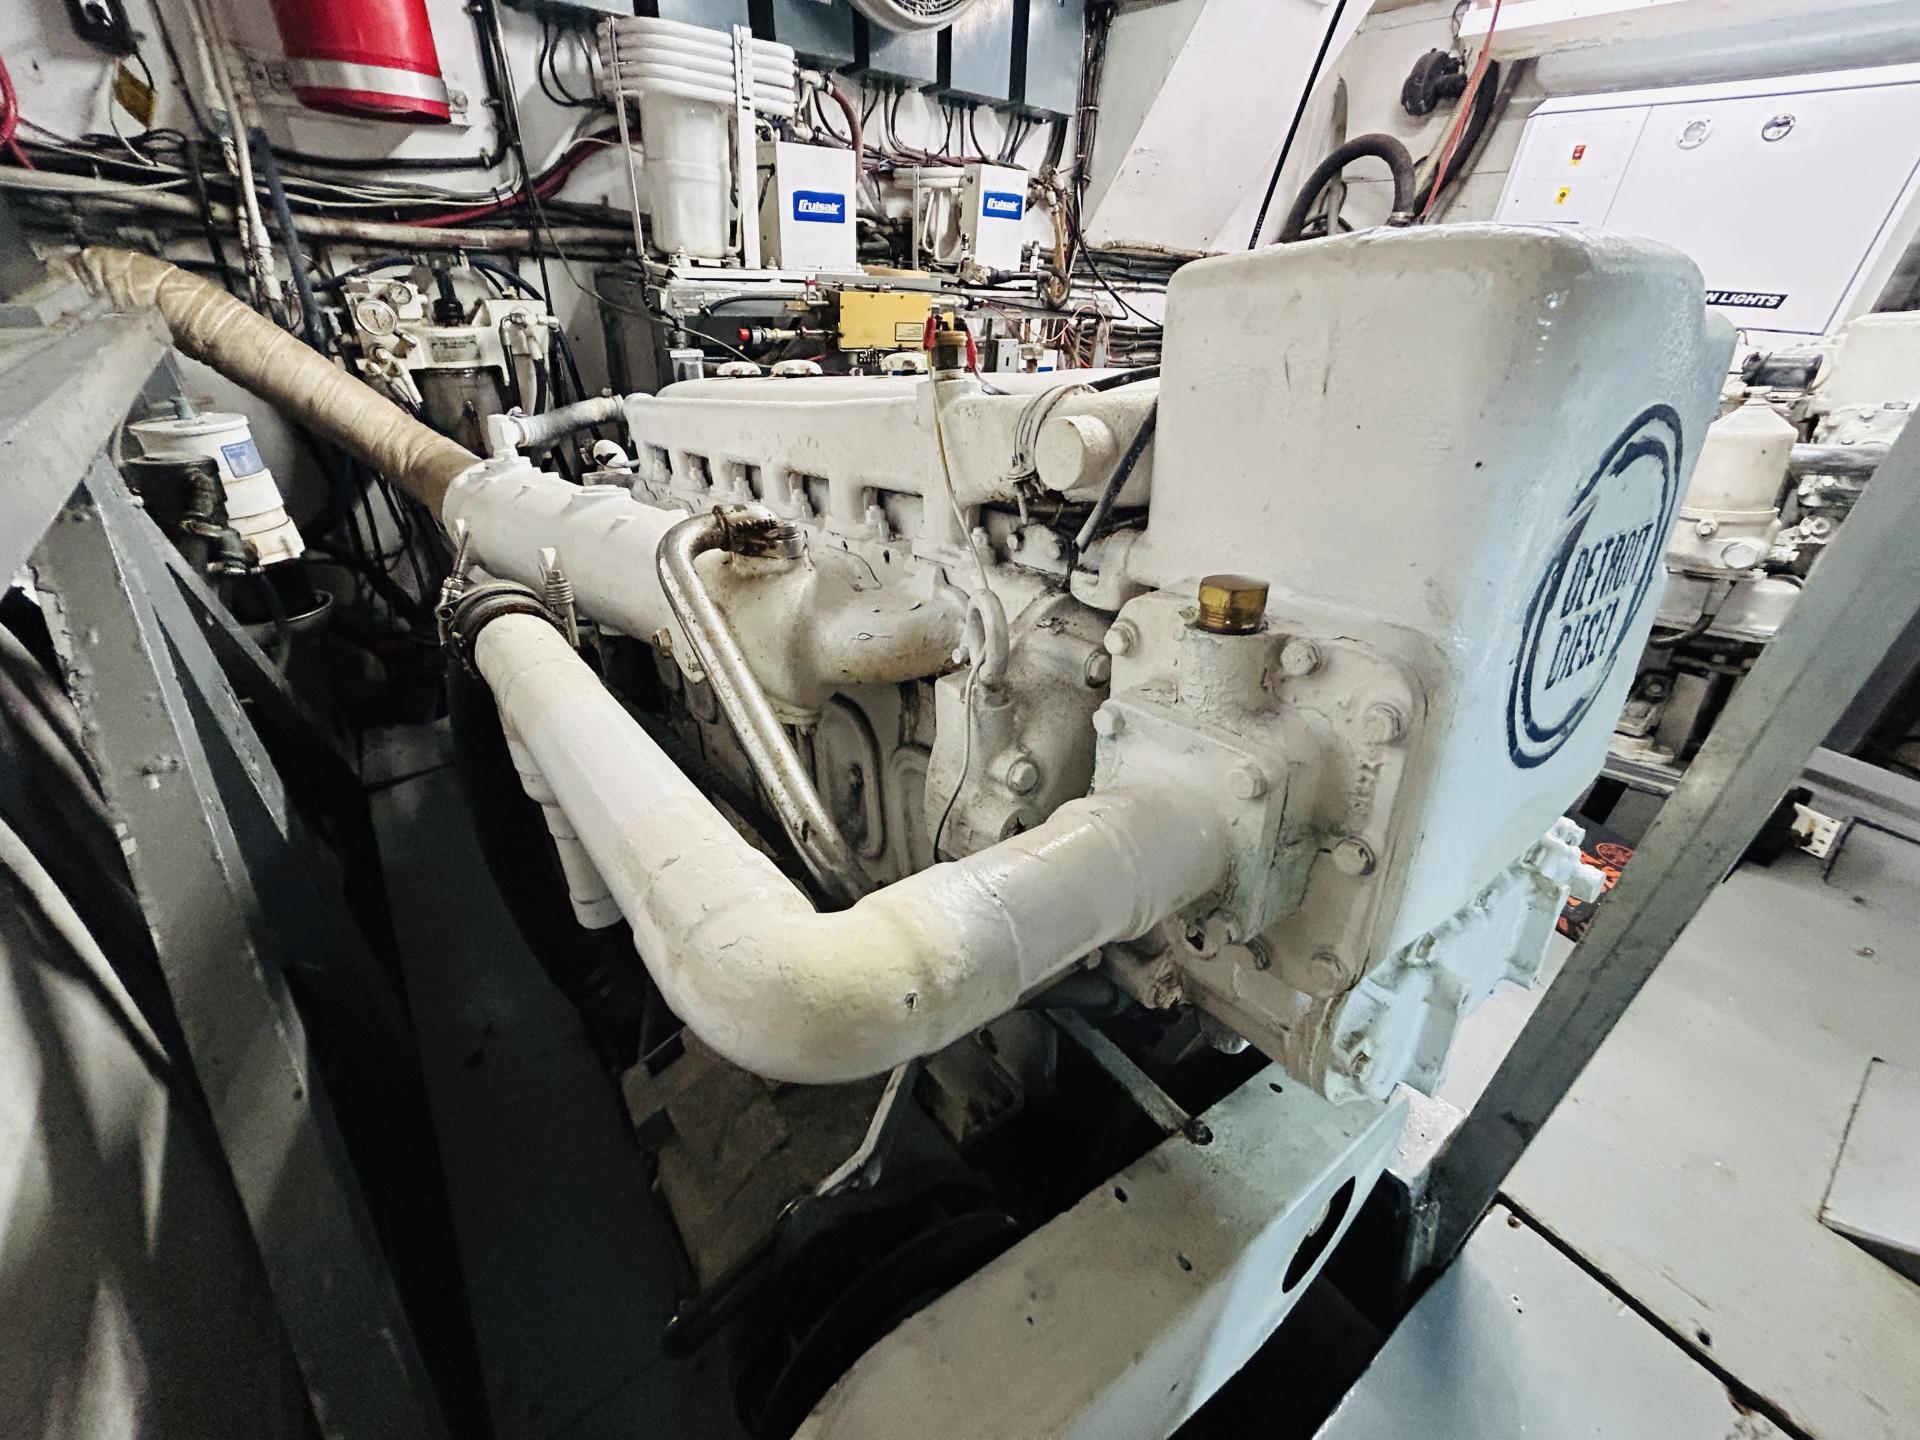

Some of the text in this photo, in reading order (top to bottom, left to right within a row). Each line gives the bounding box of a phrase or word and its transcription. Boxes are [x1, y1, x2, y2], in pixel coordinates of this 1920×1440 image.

[798, 199, 841, 215] Cruisair
[986, 197, 1020, 212] Cruisair
[1718, 292, 1780, 307] LIGHTS
[1560, 523, 1654, 618] DETROIT
[1544, 597, 1620, 690] DIESEL
